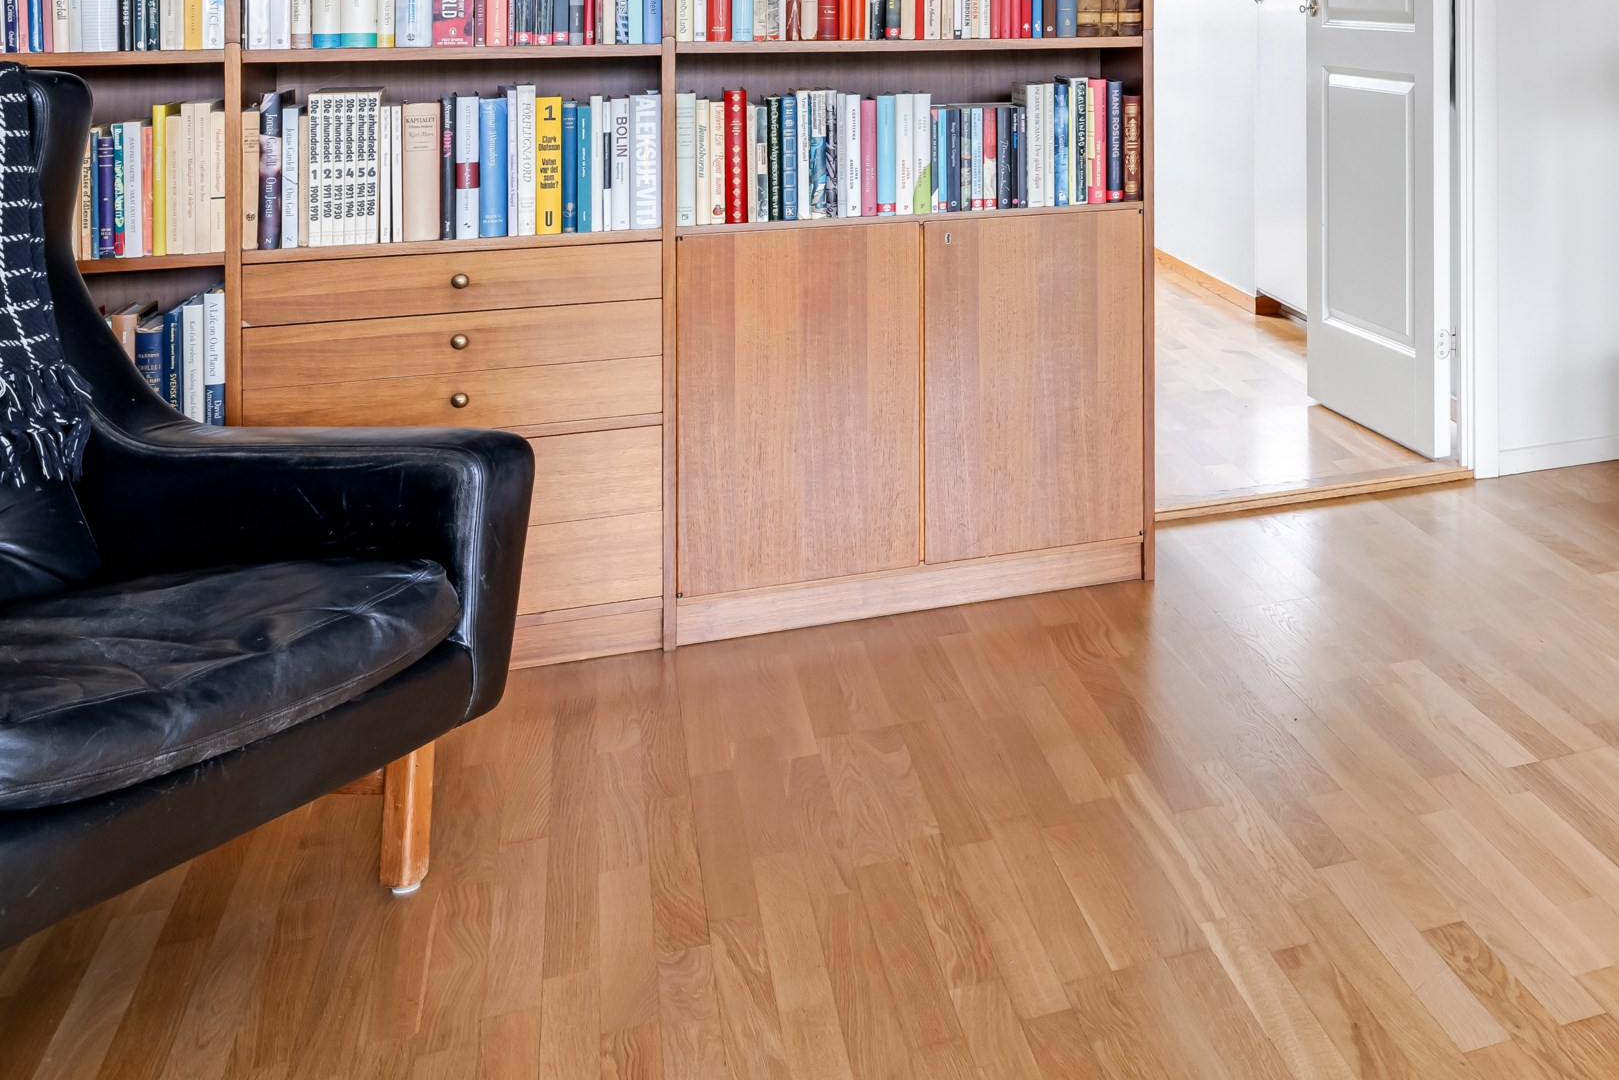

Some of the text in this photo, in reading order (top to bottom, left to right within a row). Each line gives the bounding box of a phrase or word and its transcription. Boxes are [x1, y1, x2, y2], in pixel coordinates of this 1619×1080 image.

[7, 31, 15, 47] Oxford
[310, 99, 320, 114] 20e
[323, 99, 333, 114] 20e
[334, 99, 344, 113] 20e
[346, 98, 355, 113] 20e
[358, 98, 367, 113] 20e
[368, 97, 378, 112] 20e
[543, 104, 557, 121] 1
[265, 112, 278, 136] Jonas
[1112, 89, 1120, 158] HANS ROSLING
[310, 115, 320, 164] århundradet
[323, 115, 333, 164] århundradet
[334, 114, 344, 163] århundradet
[346, 115, 355, 163] århundradet
[357, 113, 367, 162] århundradet
[367, 113, 378, 161] århundradet
[521, 102, 533, 183] FÖRFLUGNA ORD
[616, 116, 628, 158] BOLIN
[635, 96, 658, 226] ALEKSIJEVITJ
[284, 127, 295, 218] Jonas Gardell Om Gud
[311, 169, 318, 180] 1
[323, 170, 333, 179] 2
[335, 170, 343, 179] 3
[345, 169, 355, 179] 4
[358, 167, 366, 178] 5
[367, 167, 376, 177] 6
[265, 176, 277, 194] Om
[265, 194, 277, 219] Jesus
[209, 302, 219, 377] A Life on Our Planet
[169, 373, 177, 399] SVENSK
[214, 399, 222, 419] David
